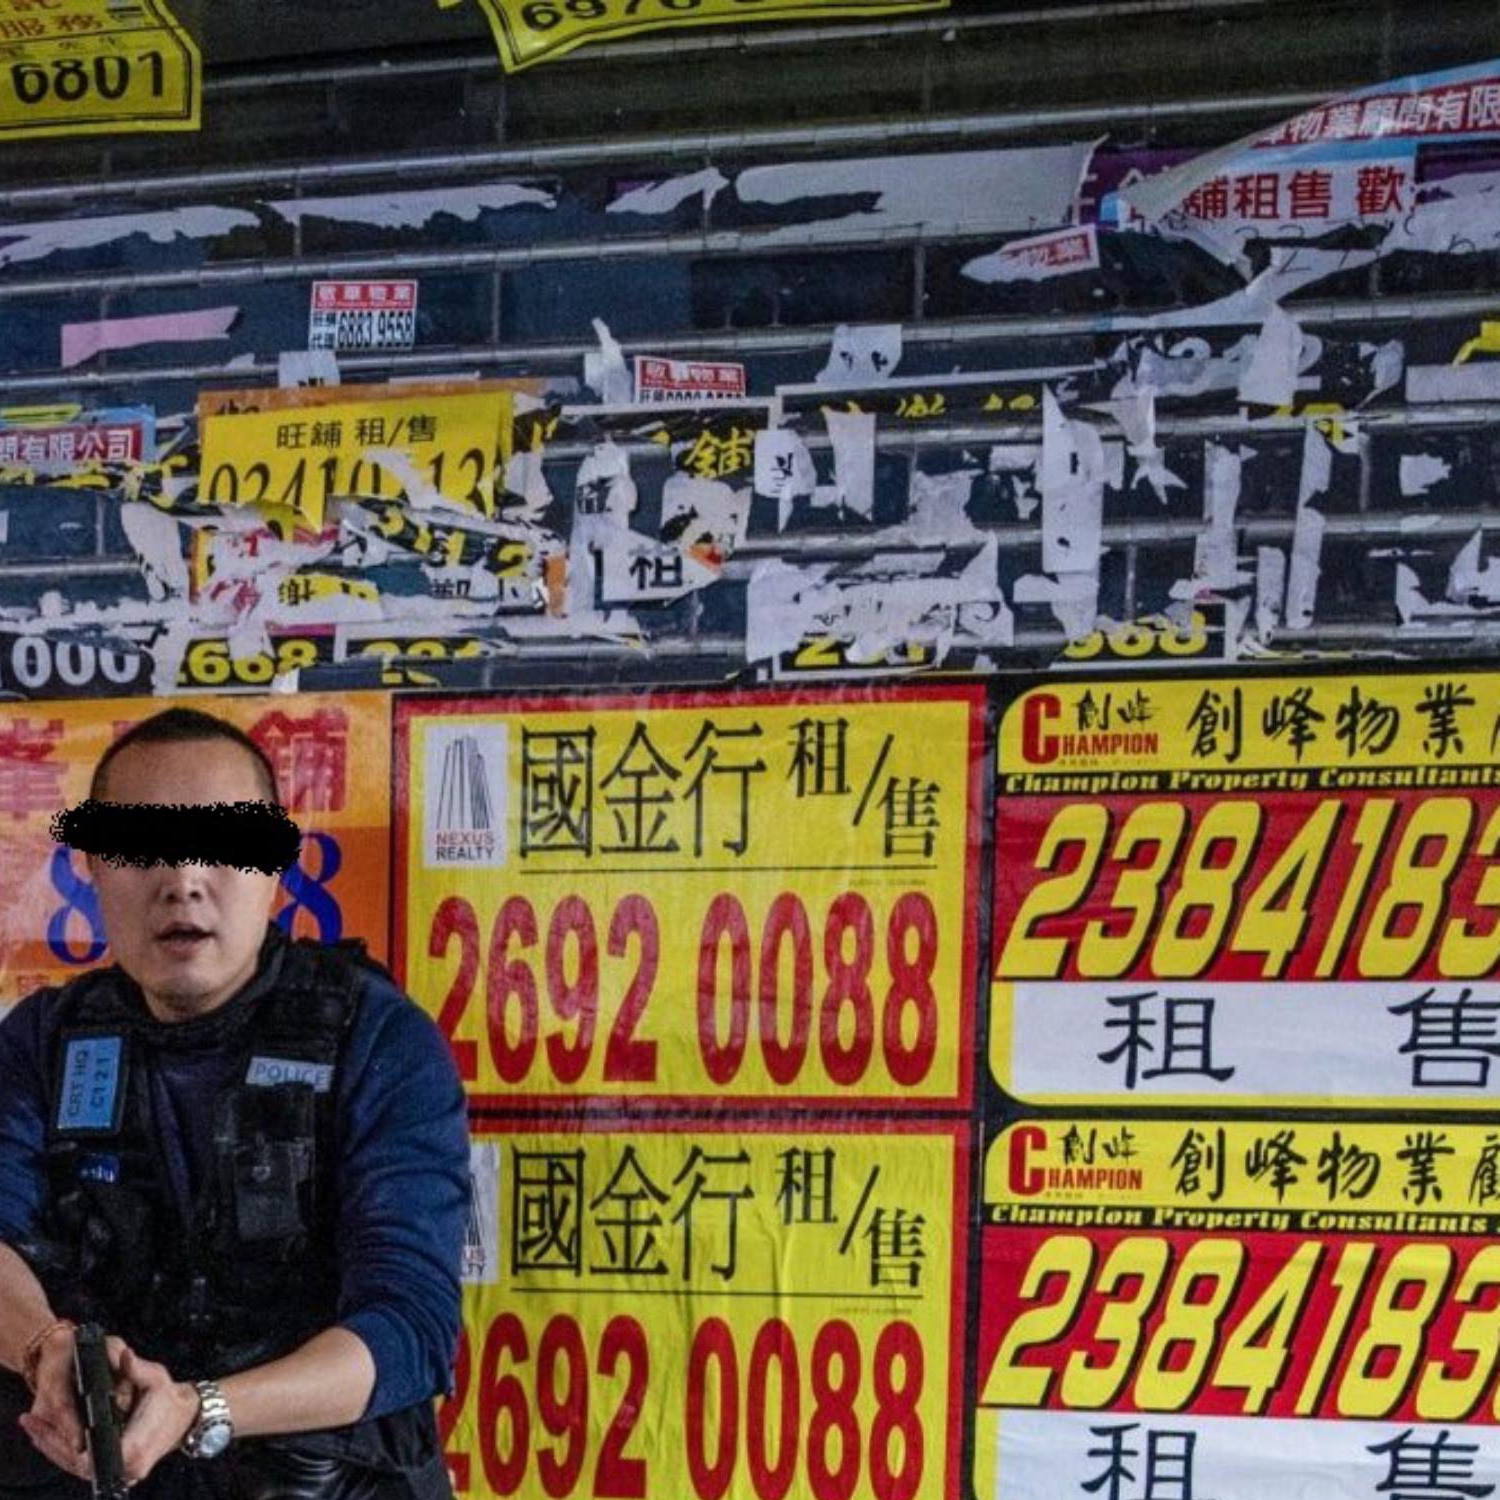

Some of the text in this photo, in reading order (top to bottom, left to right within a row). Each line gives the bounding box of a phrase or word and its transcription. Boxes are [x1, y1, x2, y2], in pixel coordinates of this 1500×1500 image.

[1022, 692, 1159, 765] CHAMPION
[1185, 682, 1500, 764] 創峰物業
[518, 717, 769, 860] 國金行
[1006, 771, 1158, 794] Champion
[1170, 769, 1309, 792] Property
[435, 829, 496, 846] NEXUS
[435, 845, 496, 862] REALTY
[428, 890, 940, 1087] 2692 0088
[254, 1060, 331, 1087] POLICE
[1096, 986, 1500, 1091] 租 售
[1007, 1124, 1144, 1197] CHAMPION
[509, 1144, 756, 1283] 國金行
[992, 1205, 1489, 1234] Champion Property Consultants
[980, 1234, 1500, 1422] 2384183
